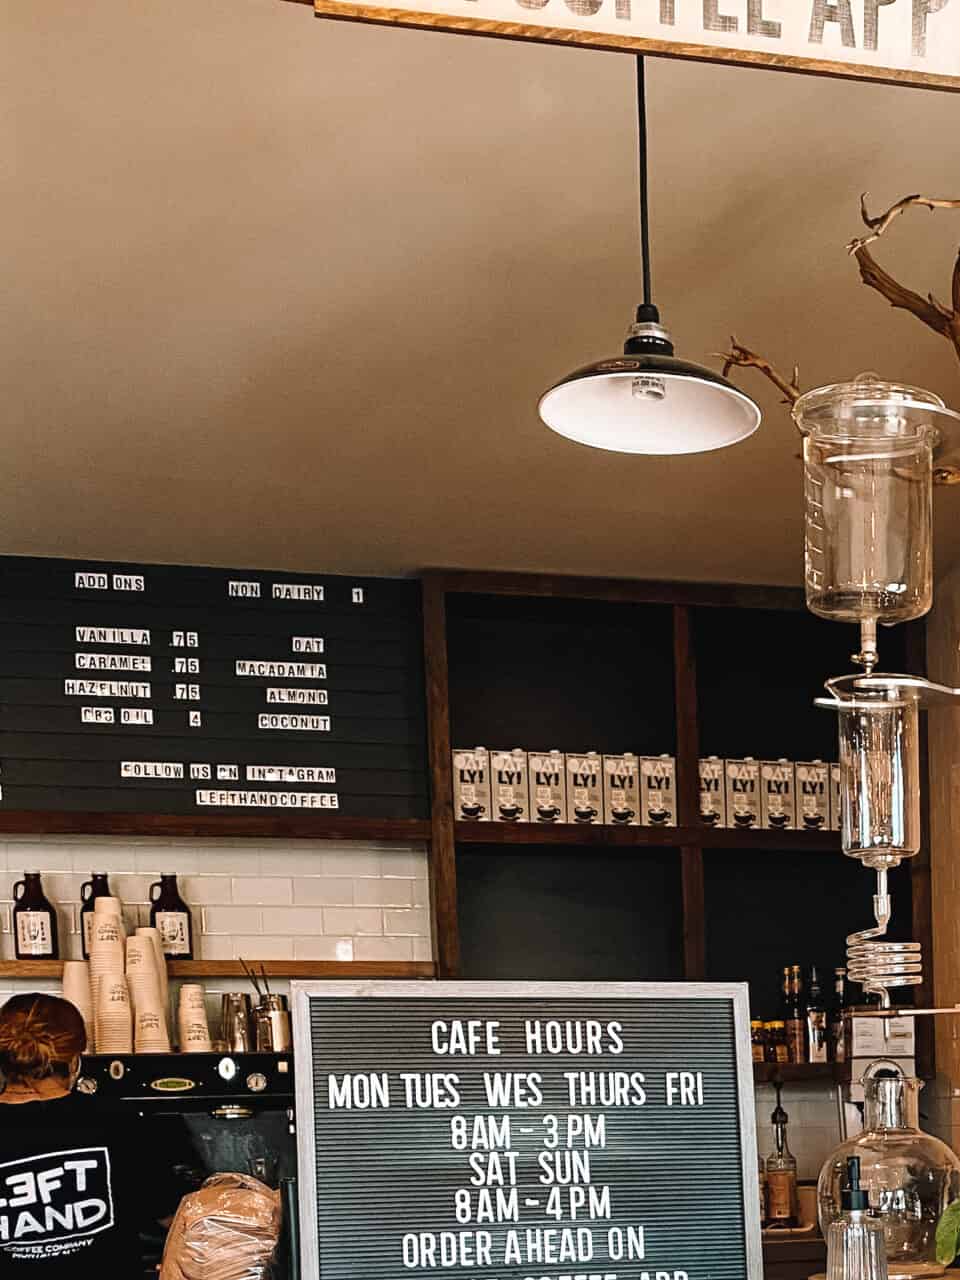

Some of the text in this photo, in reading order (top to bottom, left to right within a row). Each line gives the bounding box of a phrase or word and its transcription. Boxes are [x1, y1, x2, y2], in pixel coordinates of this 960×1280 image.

[75, 573, 144, 591] ADD ONS
[229, 581, 260, 597] NON
[272, 584, 324, 600] DAIRY
[76, 627, 150, 645] VANILLA
[292, 637, 324, 653] OAT
[236, 661, 327, 679] MACADAMIA
[267, 688, 328, 704] ALMOND
[258, 714, 330, 731] COCONUT
[190, 764, 211, 780] US
[459, 769, 484, 784] LY!
[498, 770, 522, 784] LY!
[535, 771, 559, 786] LY!
[573, 773, 597, 787] LY!
[610, 774, 634, 789] LY!
[647, 776, 670, 790] LY!
[733, 779, 755, 793] LY!
[767, 780, 789, 794] LY!
[802, 781, 824, 795] LY!
[431, 1020, 625, 1055] CAFE HOURS
[328, 1071, 705, 1109] MON TUES WES THURS FRI
[470, 1150, 591, 1186] SAT SUN
[402, 1226, 645, 1268] ORDER AHEAD ON
